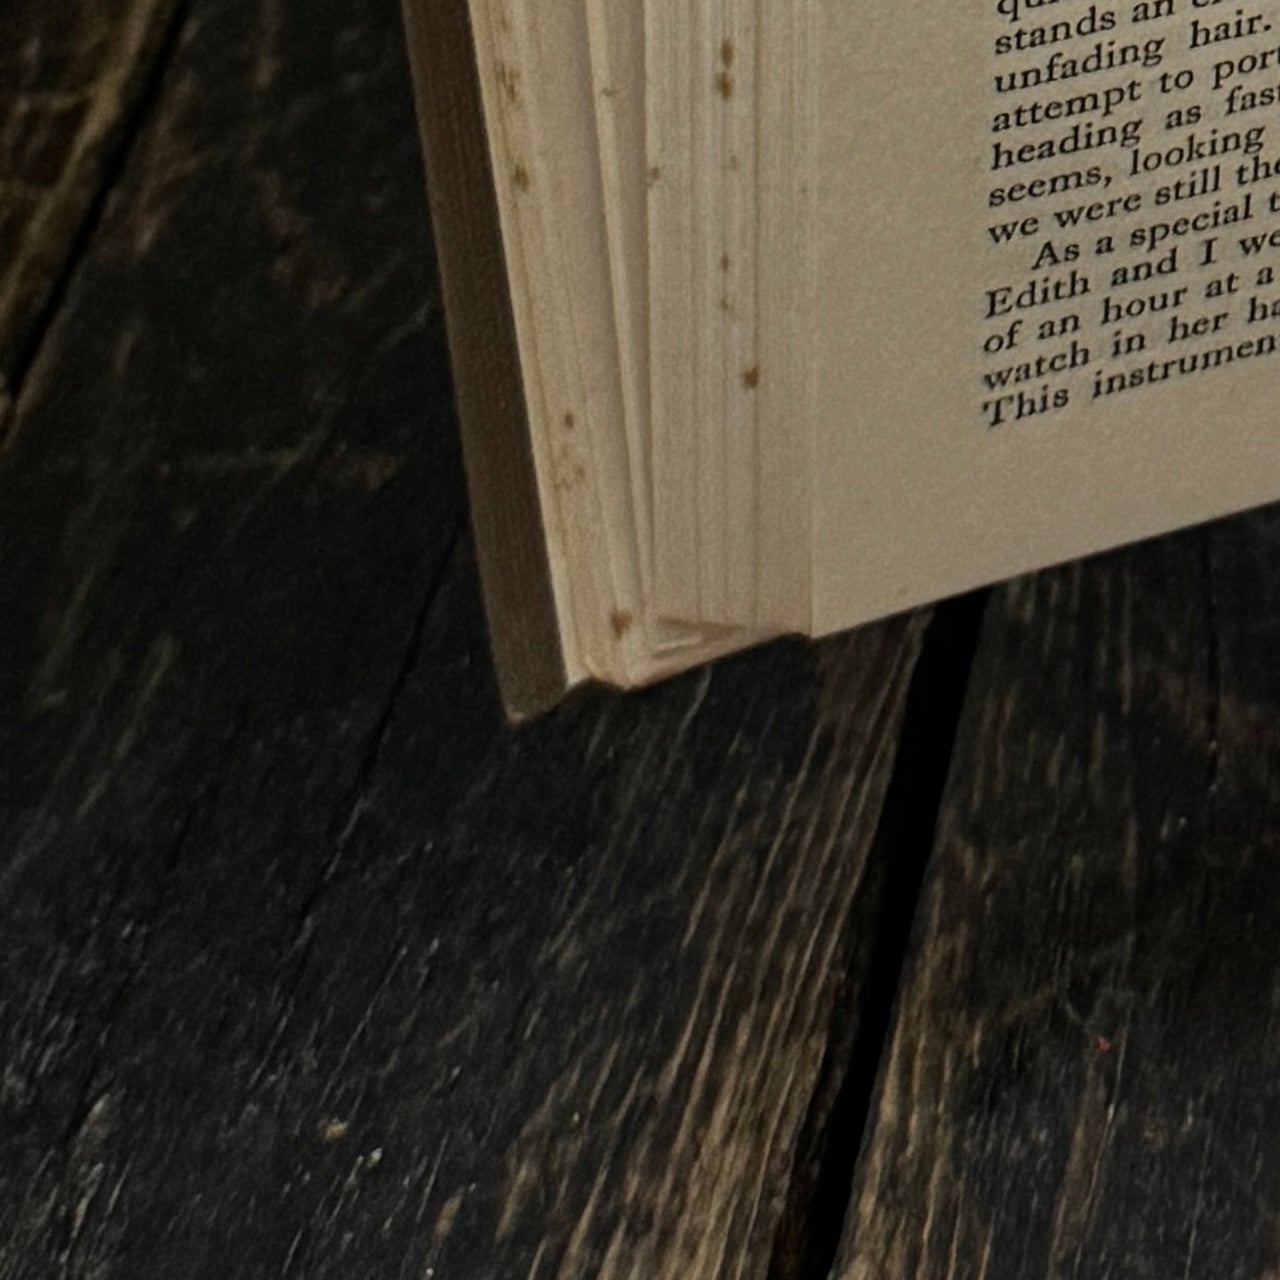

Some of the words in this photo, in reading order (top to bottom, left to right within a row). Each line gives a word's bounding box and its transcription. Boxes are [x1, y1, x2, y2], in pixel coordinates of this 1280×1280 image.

[987, 216, 1040, 244] we
[1052, 193, 1142, 229] were
[1153, 164, 1221, 207] still
